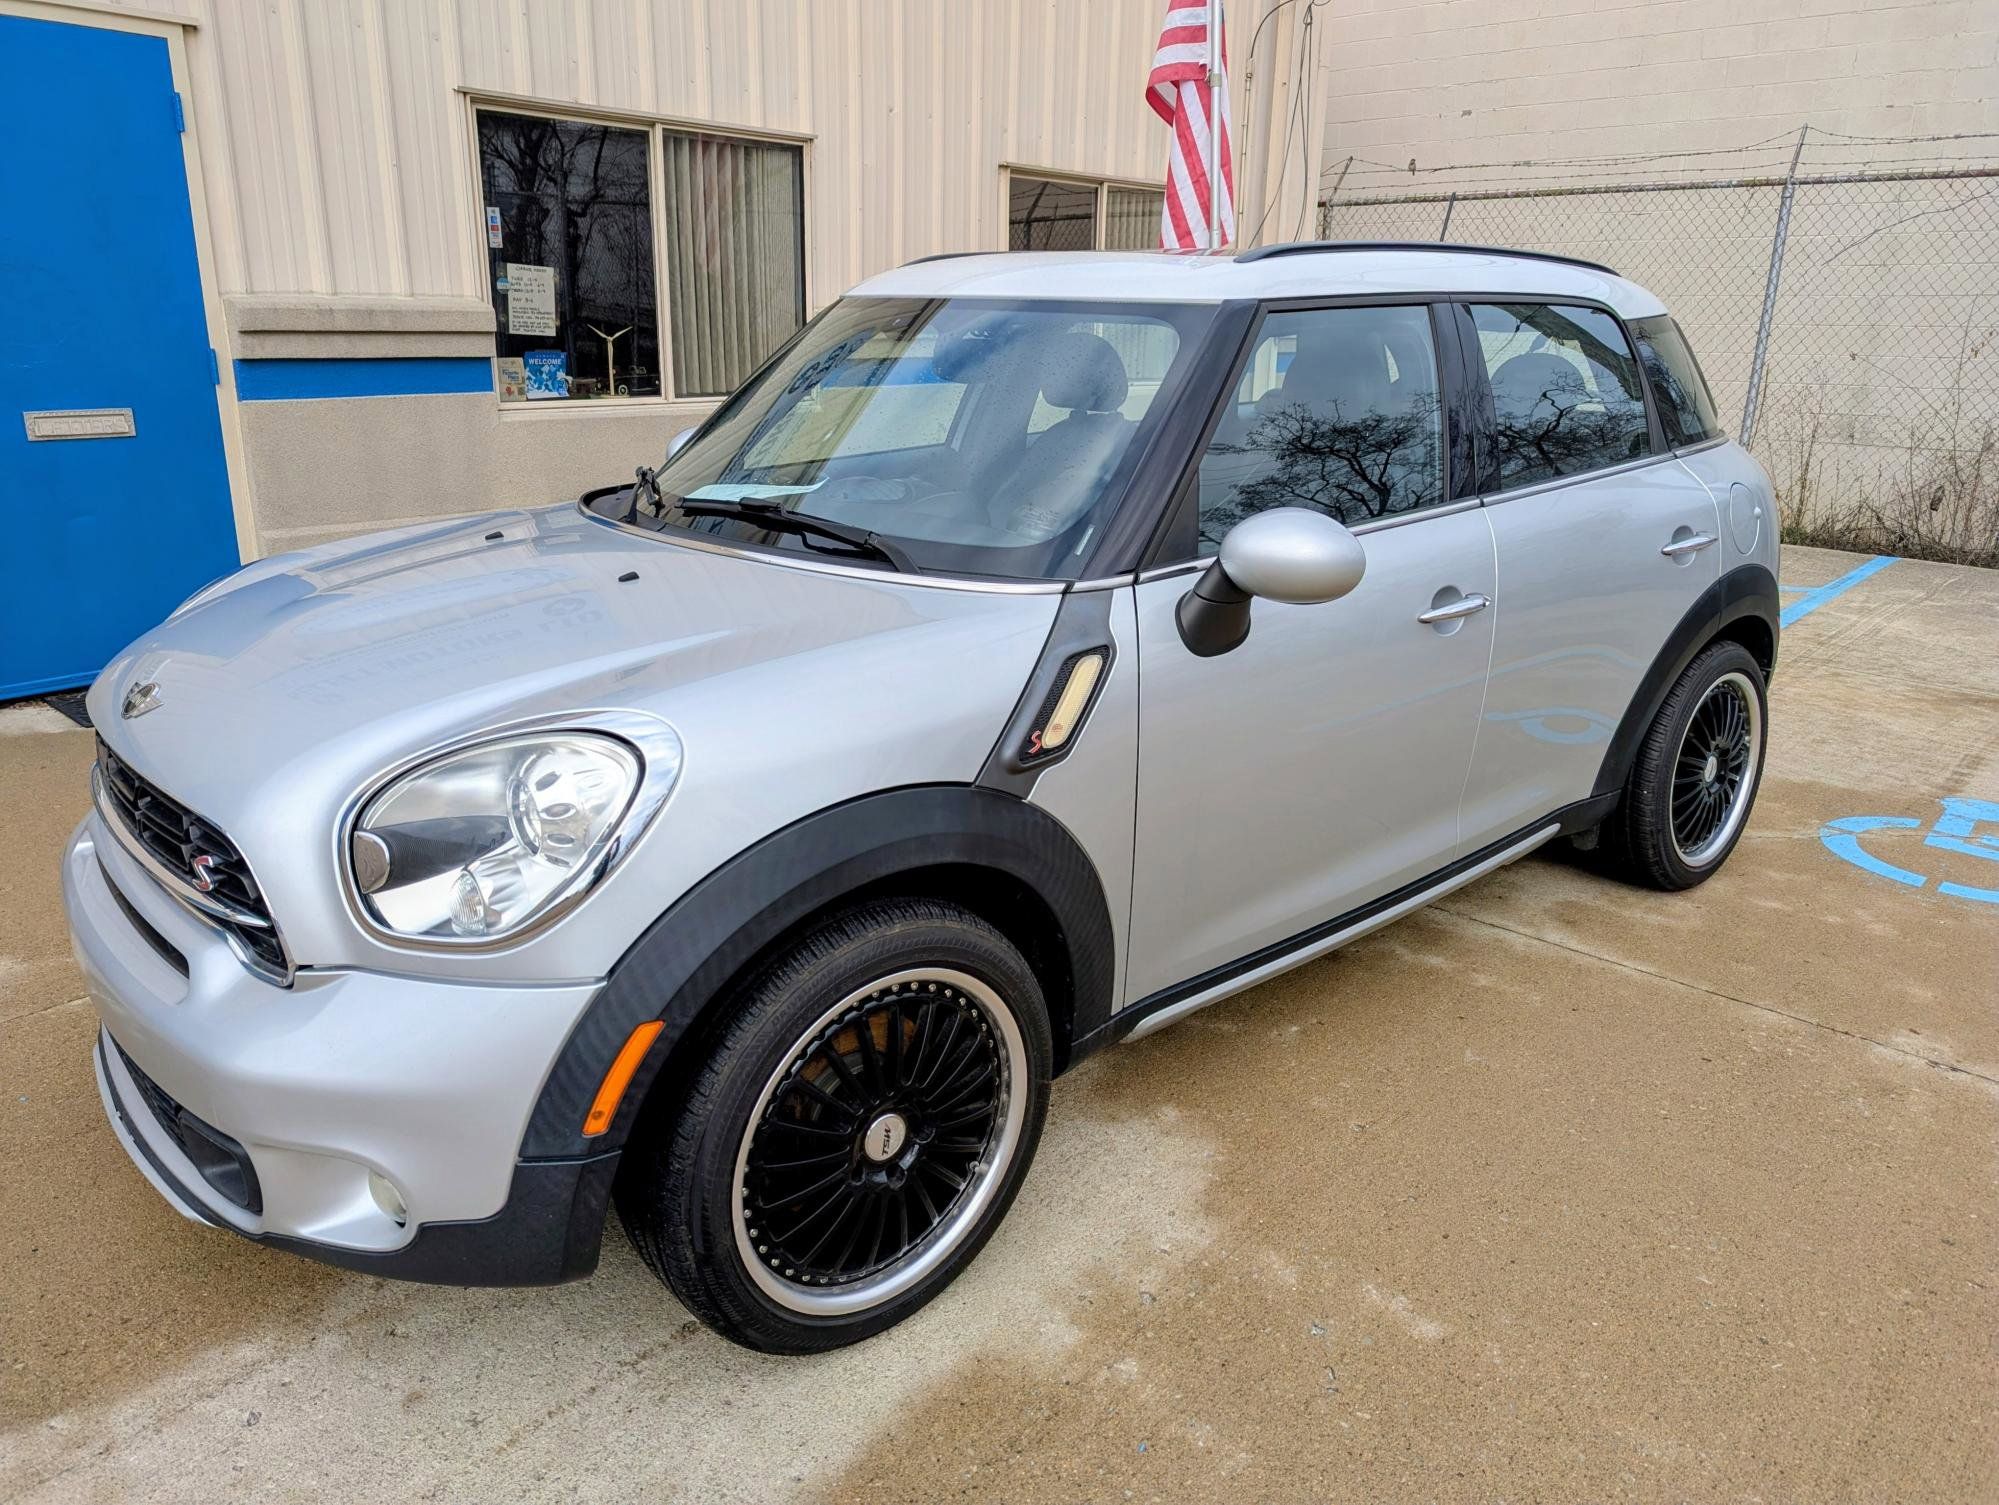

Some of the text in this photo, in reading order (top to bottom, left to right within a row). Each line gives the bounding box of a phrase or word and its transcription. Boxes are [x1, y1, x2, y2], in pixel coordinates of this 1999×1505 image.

[1028, 730, 1041, 753] S
[192, 856, 213, 891] S
[881, 1121, 891, 1156] TSW
